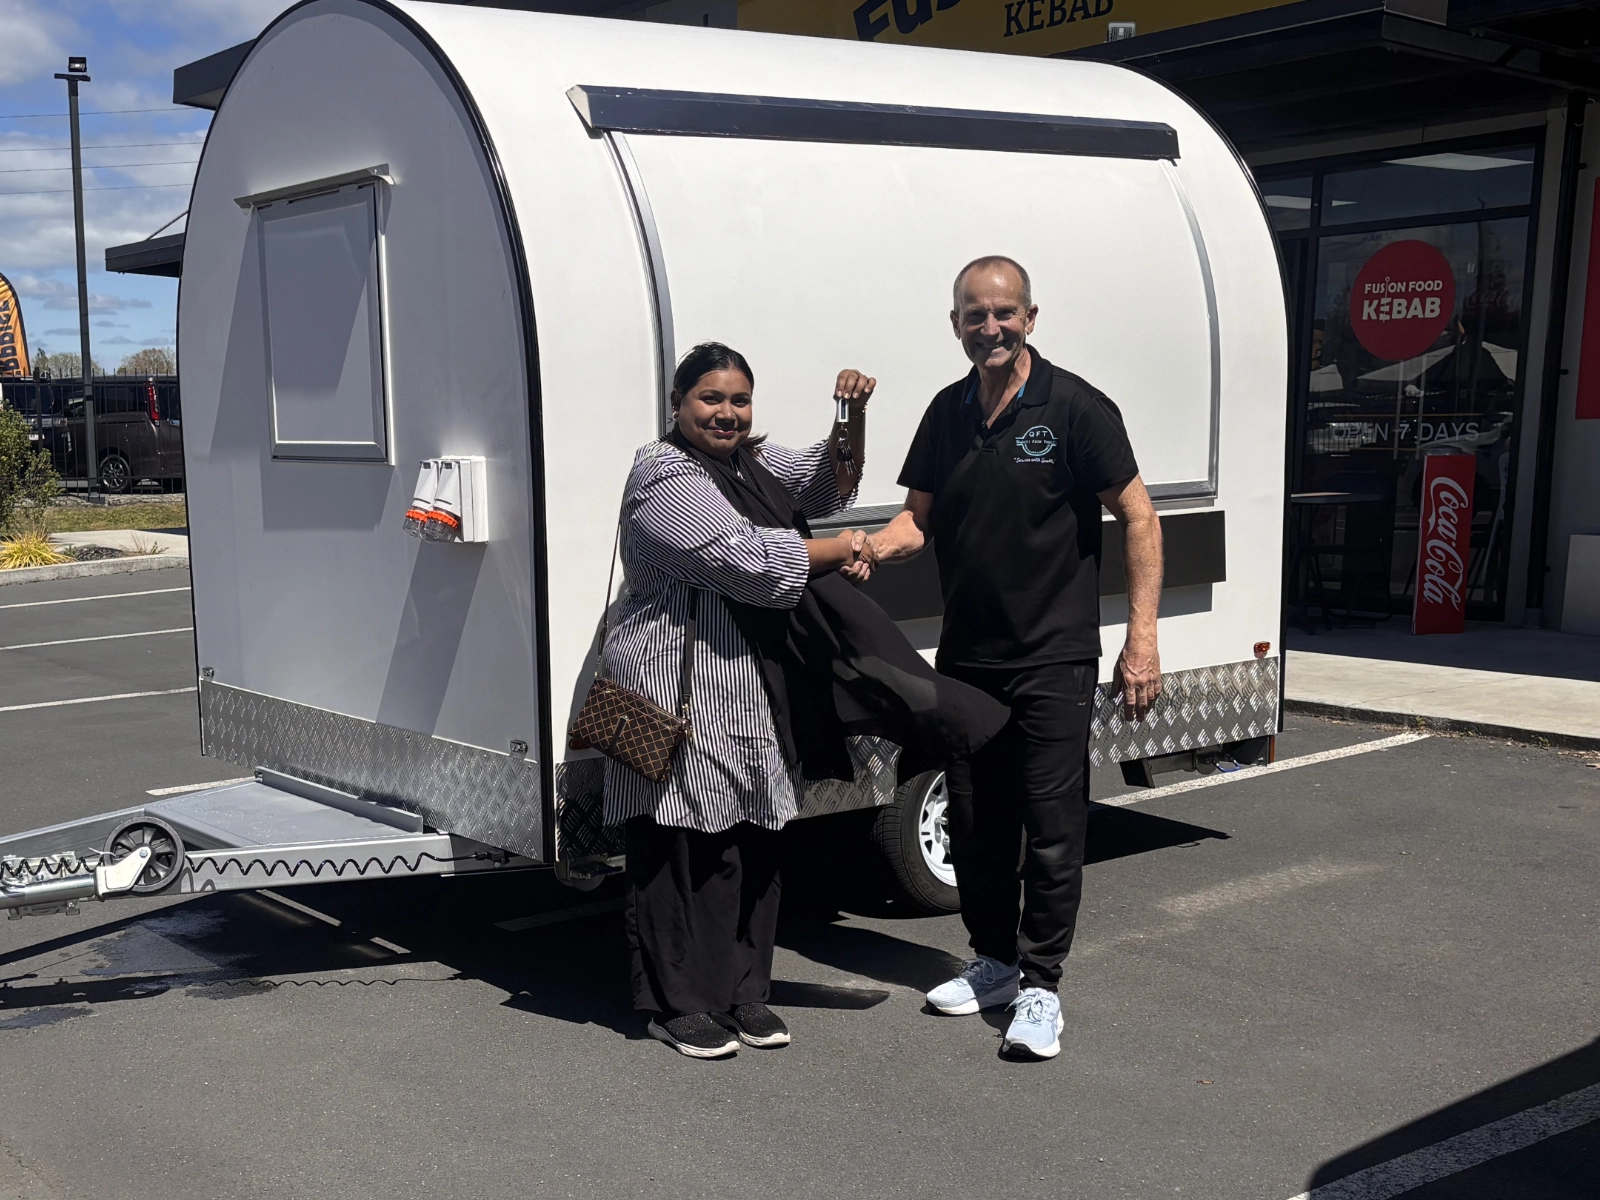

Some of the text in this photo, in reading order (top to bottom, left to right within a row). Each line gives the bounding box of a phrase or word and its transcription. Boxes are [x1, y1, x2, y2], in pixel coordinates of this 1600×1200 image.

[1364, 279, 1443, 294] FUSION FOOD
[1362, 297, 1441, 321] KEBAB
[1331, 422, 1480, 441] OPEN 7 DAYS
